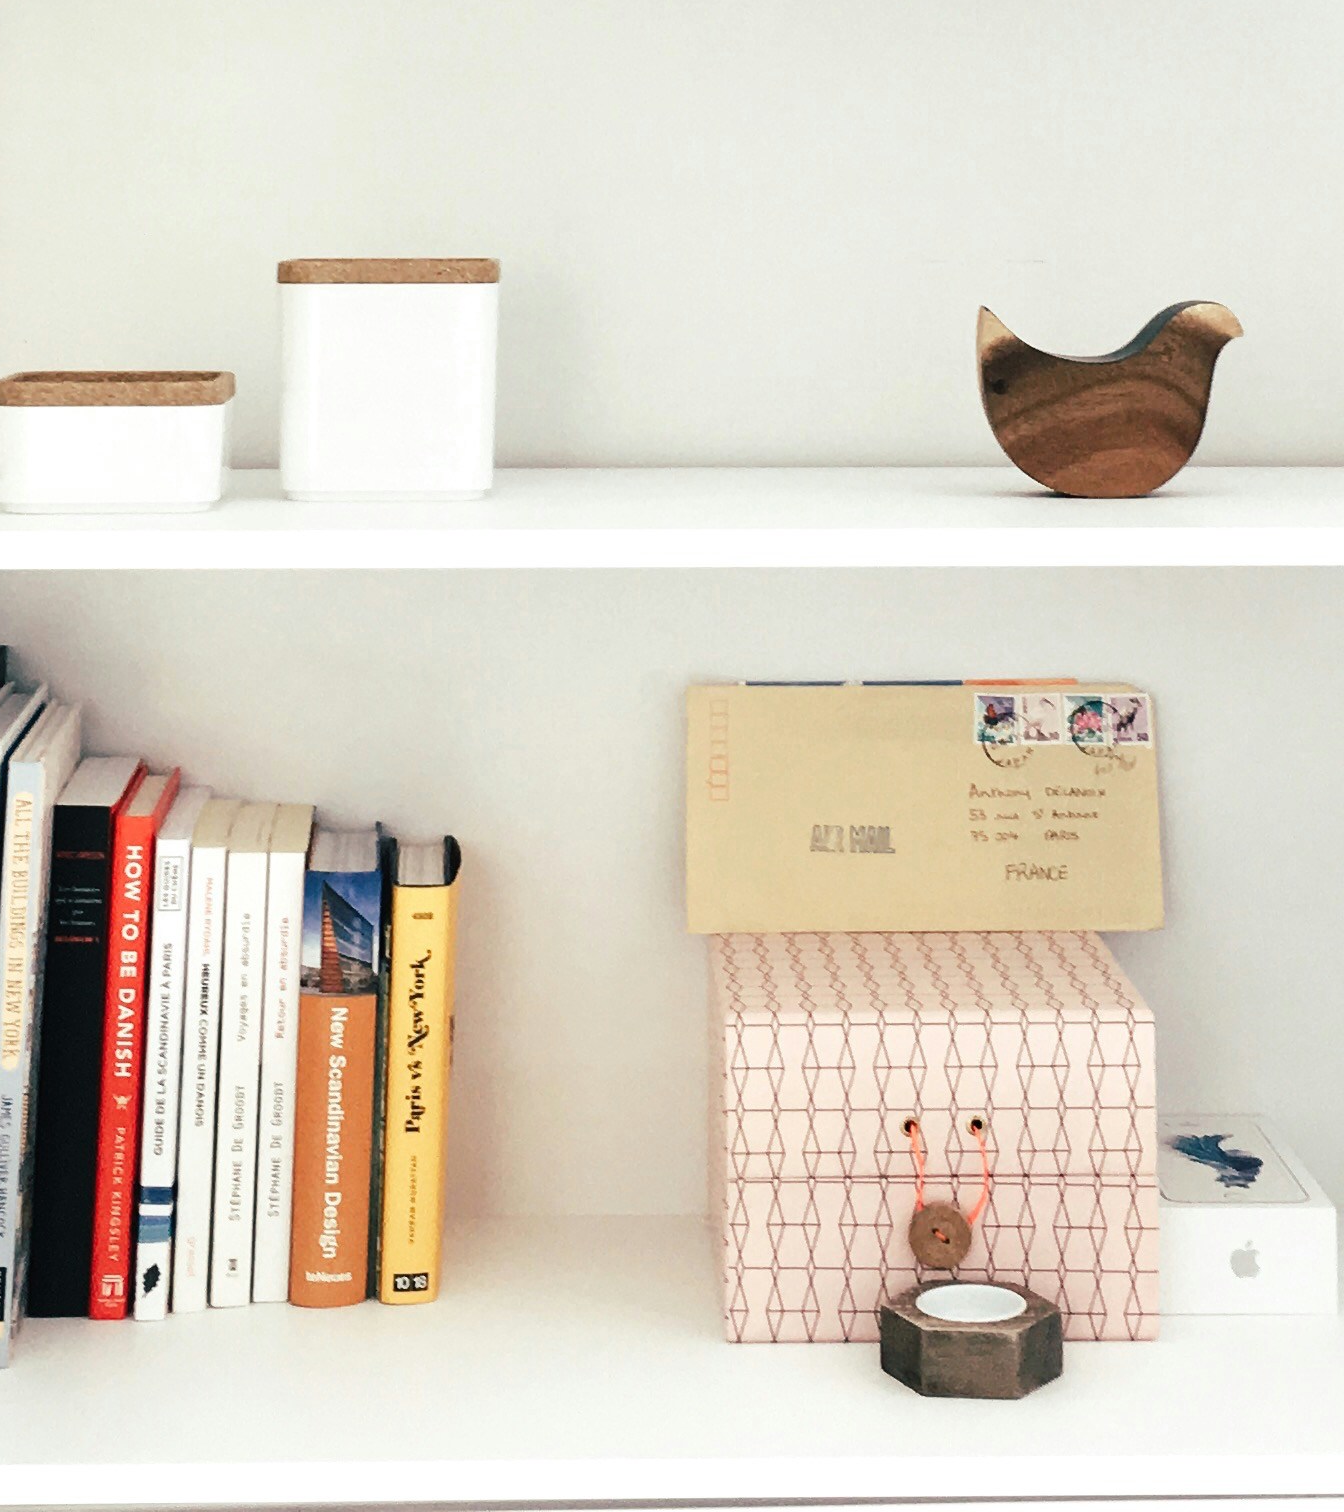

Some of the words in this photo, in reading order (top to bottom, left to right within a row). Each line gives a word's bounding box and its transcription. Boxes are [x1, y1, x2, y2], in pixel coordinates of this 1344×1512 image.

[14, 799, 33, 825] ALL
[12, 832, 30, 863] THE
[124, 846, 143, 901] HOW
[1006, 863, 1069, 881] FRANCE
[8, 871, 29, 949] BUILDINGS
[121, 909, 140, 941] TO
[162, 942, 172, 977] PARIS
[240, 913, 251, 967] absurdie
[279, 917, 290, 971] absurdie
[8, 958, 24, 972] IN
[119, 951, 137, 977] BE
[241, 973, 248, 988] en
[280, 977, 287, 991] en
[409, 949, 432, 1009] York
[6, 980, 23, 1013] NEW
[199, 963, 210, 1016] HEUREUX
[114, 988, 135, 1077] DANISH
[157, 993, 170, 1075] SCANDINAVIE
[236, 994, 250, 1042] Voyages
[274, 998, 286, 1038] Retour
[329, 1007, 349, 1048] New
[407, 1010, 429, 1055] New
[2, 1020, 21, 1059] YORK
[198, 1019, 208, 1060] COMME
[156, 1079, 167, 1095] LA
[197, 1063, 206, 1080] UN
[0, 1095, 13, 1129] JAMES
[155, 1098, 166, 1114] DE
[195, 1083, 206, 1127] DANOIS
[324, 1055, 346, 1184] Scandinavian
[404, 1086, 426, 1133] Paris
[112, 1127, 126, 1184] PATRICK
[153, 1118, 164, 1156] GUIDE
[108, 1192, 123, 1262] KINGSLEY
[319, 1192, 341, 1258] Design
[395, 1276, 410, 1289] 10
